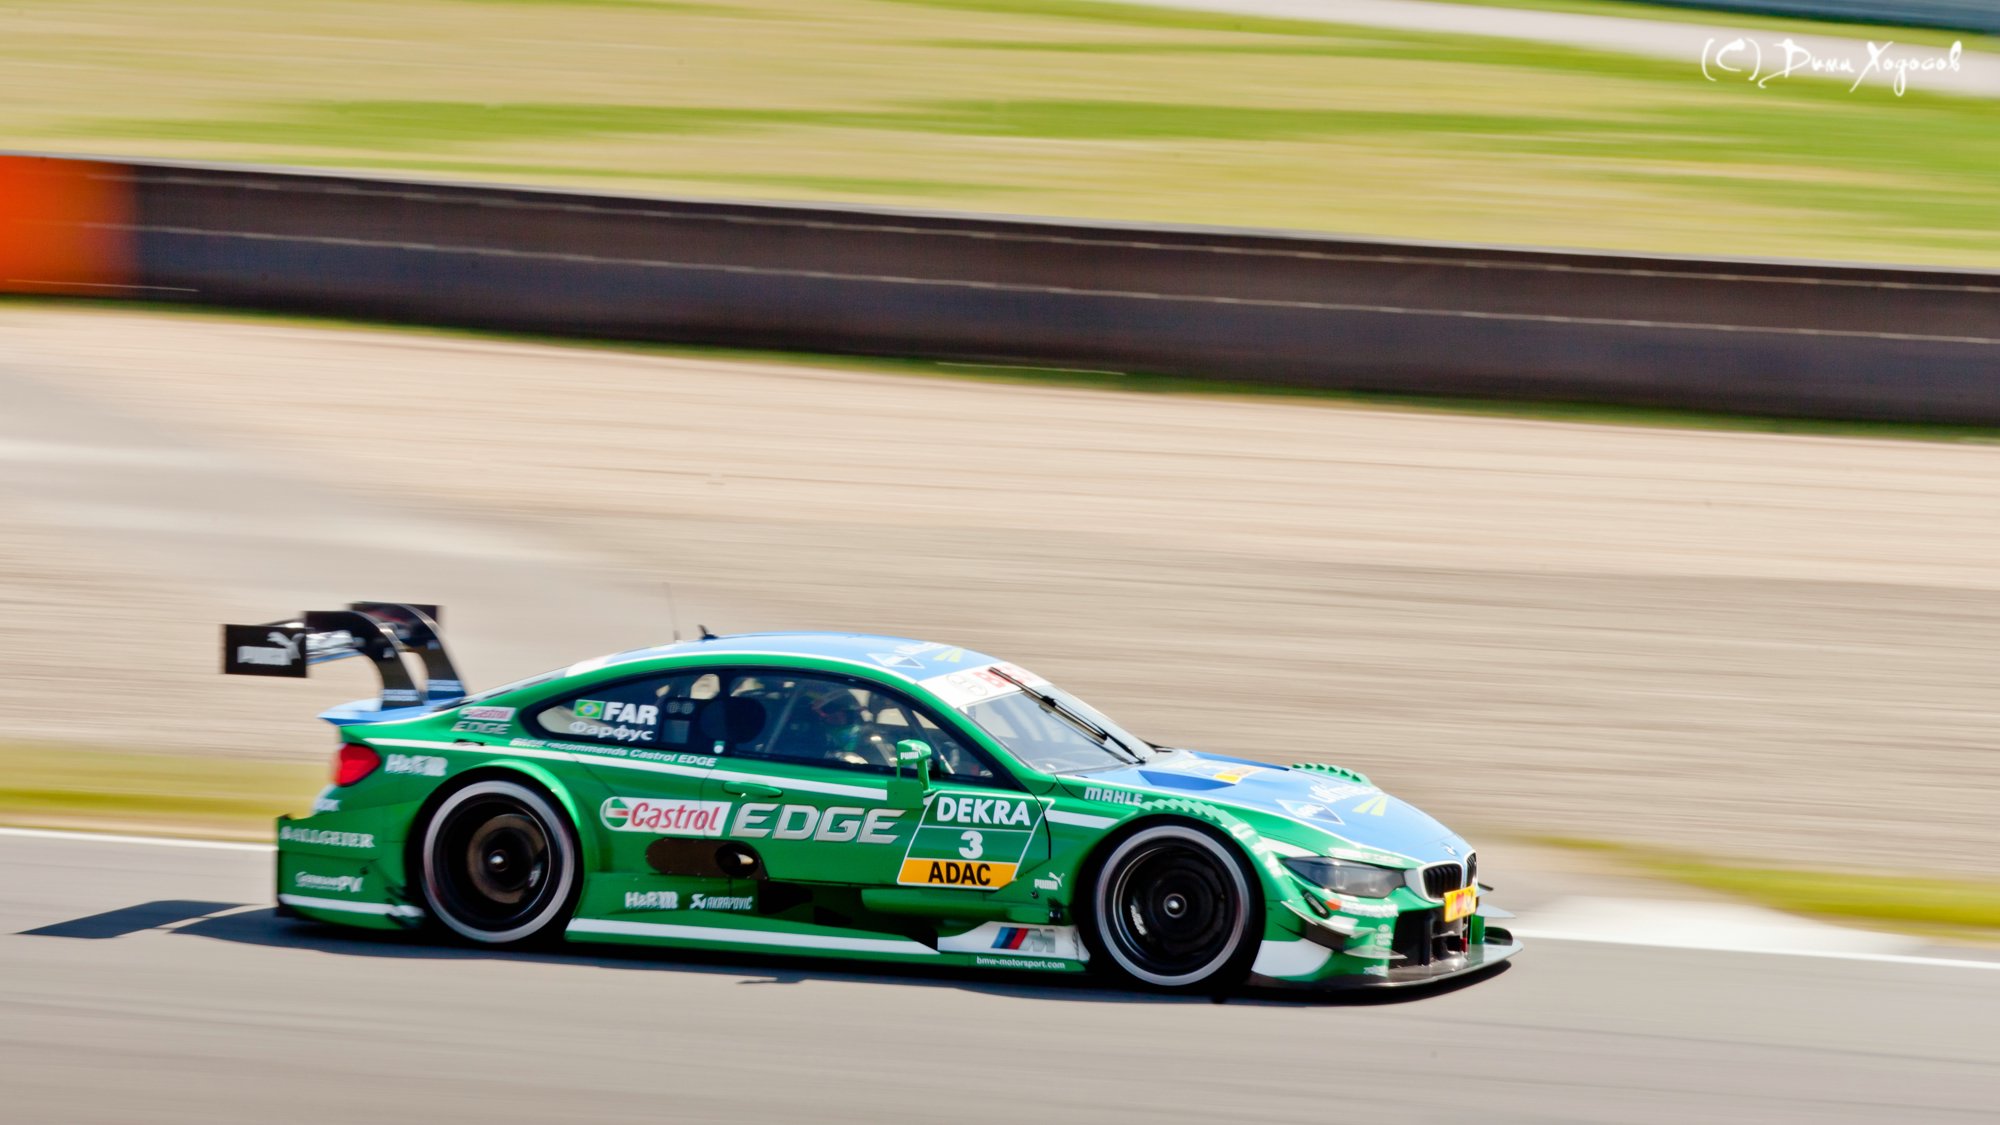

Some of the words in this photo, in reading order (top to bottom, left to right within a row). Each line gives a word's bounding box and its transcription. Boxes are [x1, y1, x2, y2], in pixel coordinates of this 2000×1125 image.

[603, 702, 659, 726] FAR
[450, 721, 512, 735] EDGE
[569, 721, 654, 742] Фарфус
[547, 742, 628, 756] recommends
[630, 749, 677, 762] Castrol
[678, 754, 717, 767] EDGE
[1084, 786, 1143, 806] MAHLE
[630, 801, 721, 832] Castrol
[730, 802, 906, 844] EDGE
[936, 797, 1031, 826] DEKRA
[958, 830, 984, 859] 3
[928, 861, 991, 886] ADAC
[976, 956, 1066, 969] bmw-motorsport.com
